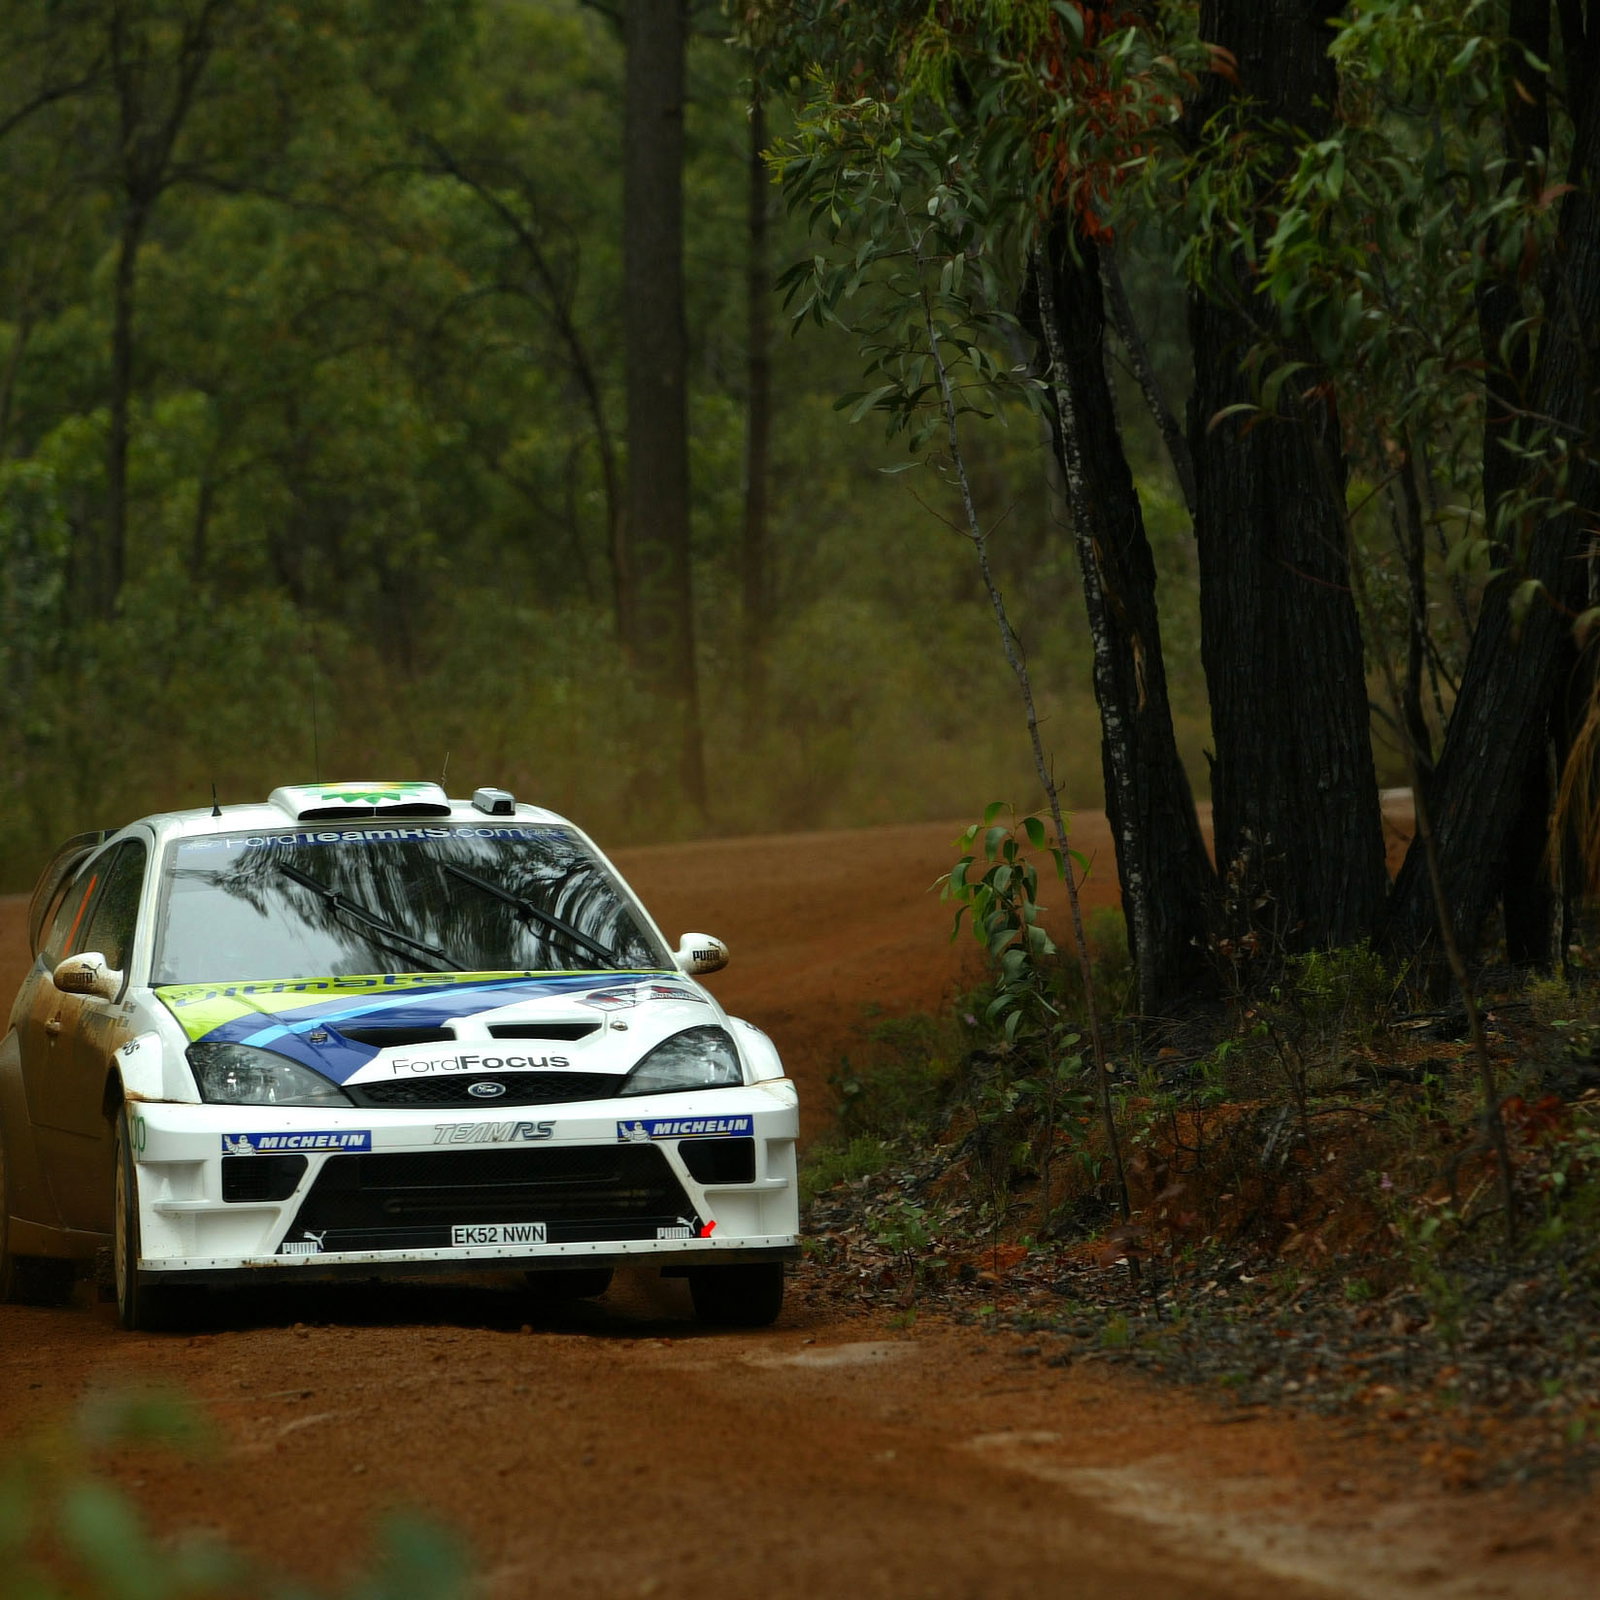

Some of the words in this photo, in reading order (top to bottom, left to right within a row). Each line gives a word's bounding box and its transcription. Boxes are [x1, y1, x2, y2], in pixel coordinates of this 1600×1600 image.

[225, 827, 525, 849] FordTeamRS.com
[63, 972, 93, 984] UMA
[392, 1055, 570, 1075] FordFocus
[433, 1120, 557, 1145] TEAMRS
[652, 1119, 749, 1135] MICHELIN
[258, 1134, 366, 1149] MICHELIN
[454, 1227, 498, 1244] EK52
[503, 1225, 544, 1242] NWN
[657, 1227, 690, 1240] PUMA
